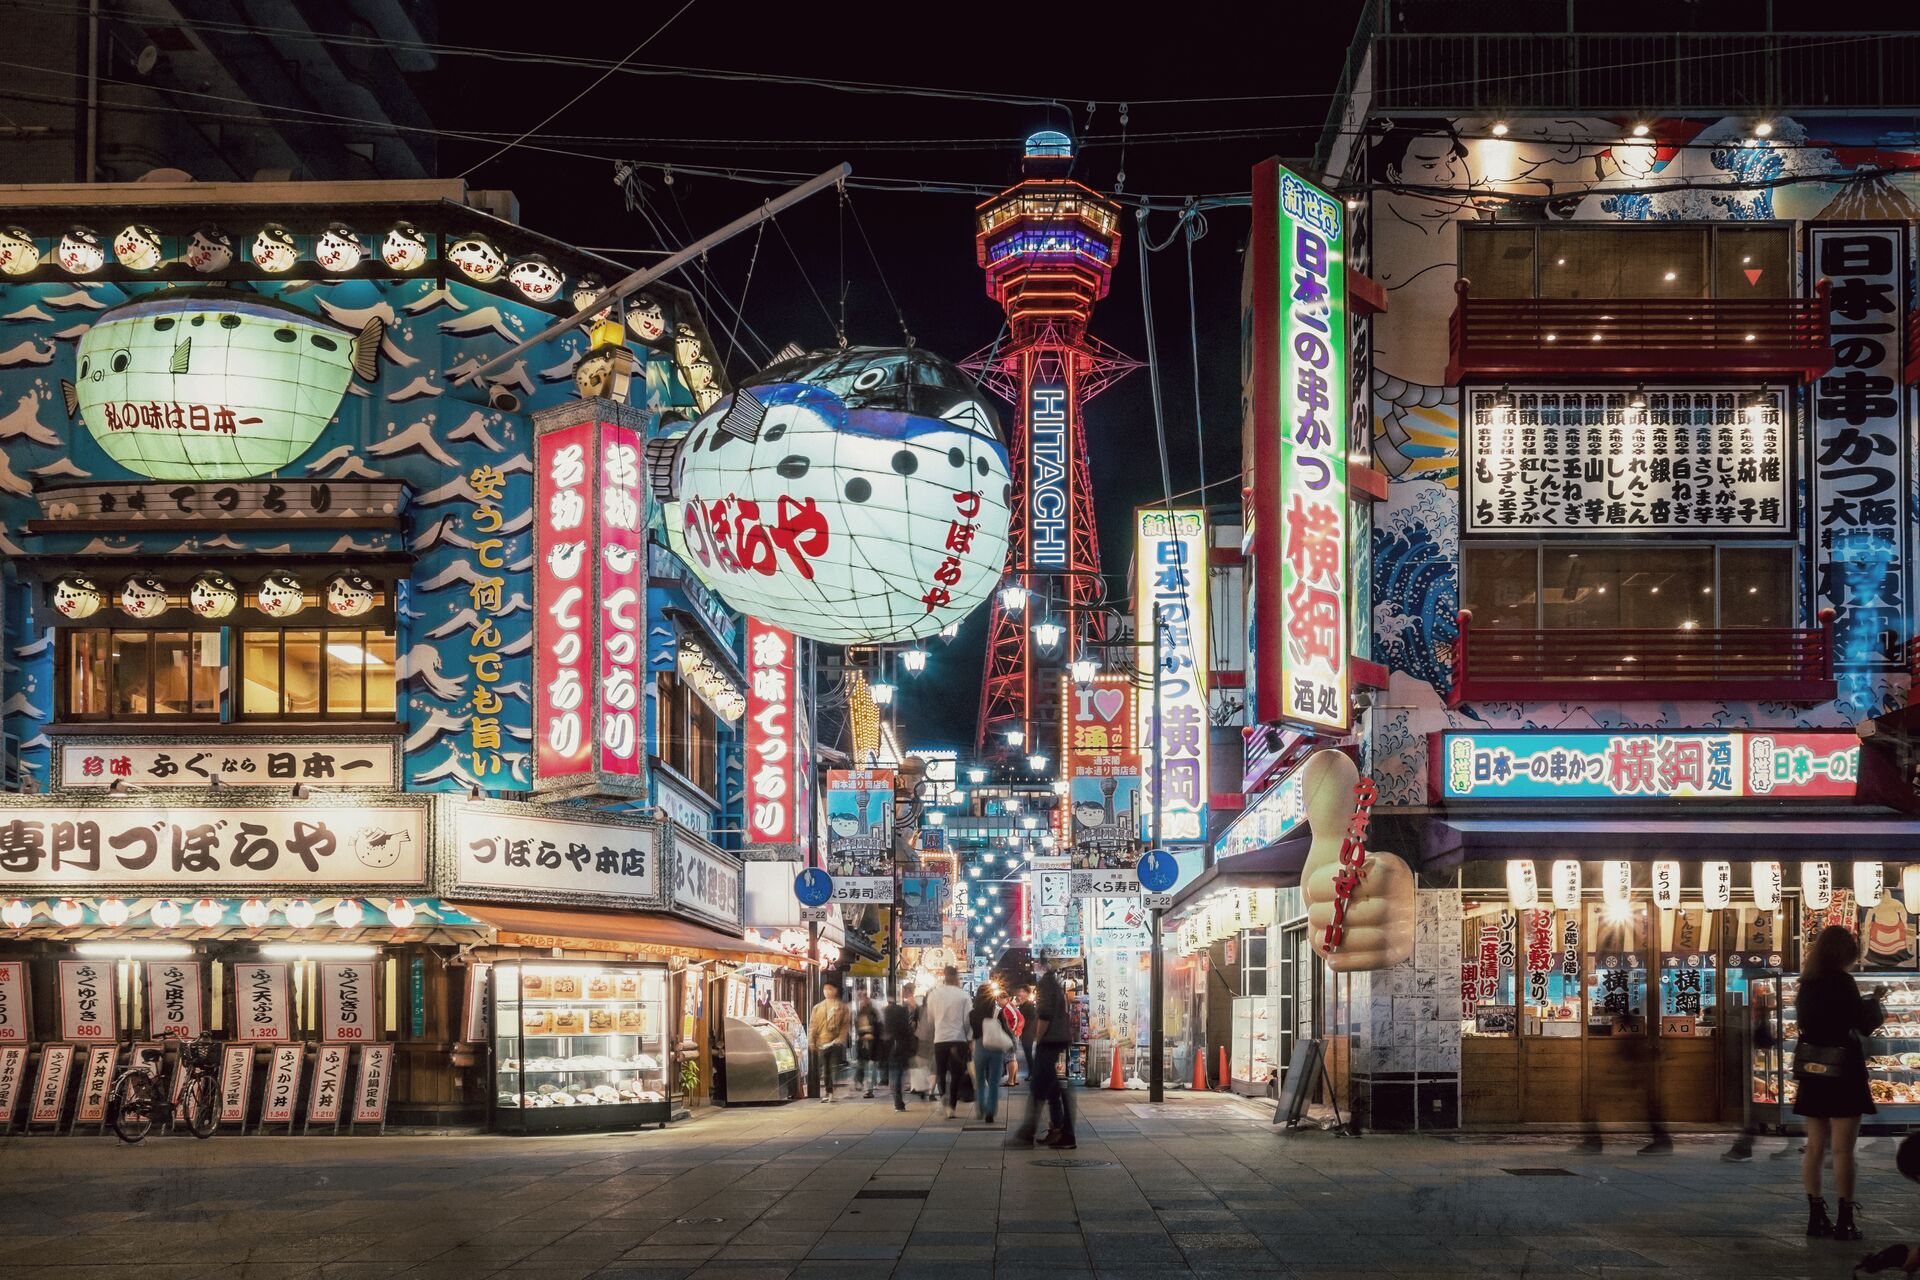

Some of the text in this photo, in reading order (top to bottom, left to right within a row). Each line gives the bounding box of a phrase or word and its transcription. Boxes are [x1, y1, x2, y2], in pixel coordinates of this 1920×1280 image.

[1816, 235, 1898, 499] 日本一の串かつ
[104, 401, 264, 435] 私の味は日本一
[1281, 174, 1342, 720] 新世界 日本一の串かつ 横綱 酒処
[1032, 389, 1067, 565] HITACHI
[683, 491, 830, 581] づぼらや
[1820, 498, 1897, 527] 大阪
[922, 489, 985, 614] づぼらや
[469, 464, 507, 777] 安うて何んでも旨い
[548, 444, 587, 758] 名物 てっちり
[601, 441, 638, 759] 名物 てっちり
[1075, 689, 1094, 721] I
[82, 752, 374, 779] 珍味 ふぐなら日本一
[1073, 725, 1109, 756] 通
[1093, 755, 1121, 765] 通天閣
[1752, 740, 1771, 791] 新世界
[1075, 766, 1138, 776] 南本通り商店会
[1452, 740, 1733, 794] 新世界 日本一の串かつ 横綱 酒処
[469, 834, 646, 878] づぼらや本店
[674, 848, 737, 916] ふぐ料理専門
[1093, 881, 1140, 893] くら寿司
[1658, 870, 1671, 901] もつ鍋
[1719, 872, 1729, 902] 串かつ
[1500, 915, 1515, 966] ソースの
[1753, 915, 1766, 944] もち
[1480, 926, 1499, 997] 二度漬け
[77, 965, 98, 1022] ふぐゆびき
[164, 966, 185, 1023] ふぐ皮ちり
[251, 968, 273, 1024] ふぐ天ぷら
[338, 967, 360, 1023] ふぐにぎり
[1118, 986, 1129, 1037] 欢迎使用
[1460, 962, 1478, 1019] 御免!!
[1603, 969, 1630, 1015] 横綱
[1674, 969, 1701, 1015] 横綱
[77, 1025, 102, 1036] 880
[338, 1027, 362, 1038] 880
[1617, 1024, 1640, 1033] 入口
[1668, 1024, 1690, 1033] 入口
[89, 1051, 109, 1106] 天丼定食
[273, 1050, 295, 1108] ふぐかつ丼
[318, 1050, 340, 1108] ふぐ天丼
[365, 1050, 383, 1108] ふぐ小鍋定食
